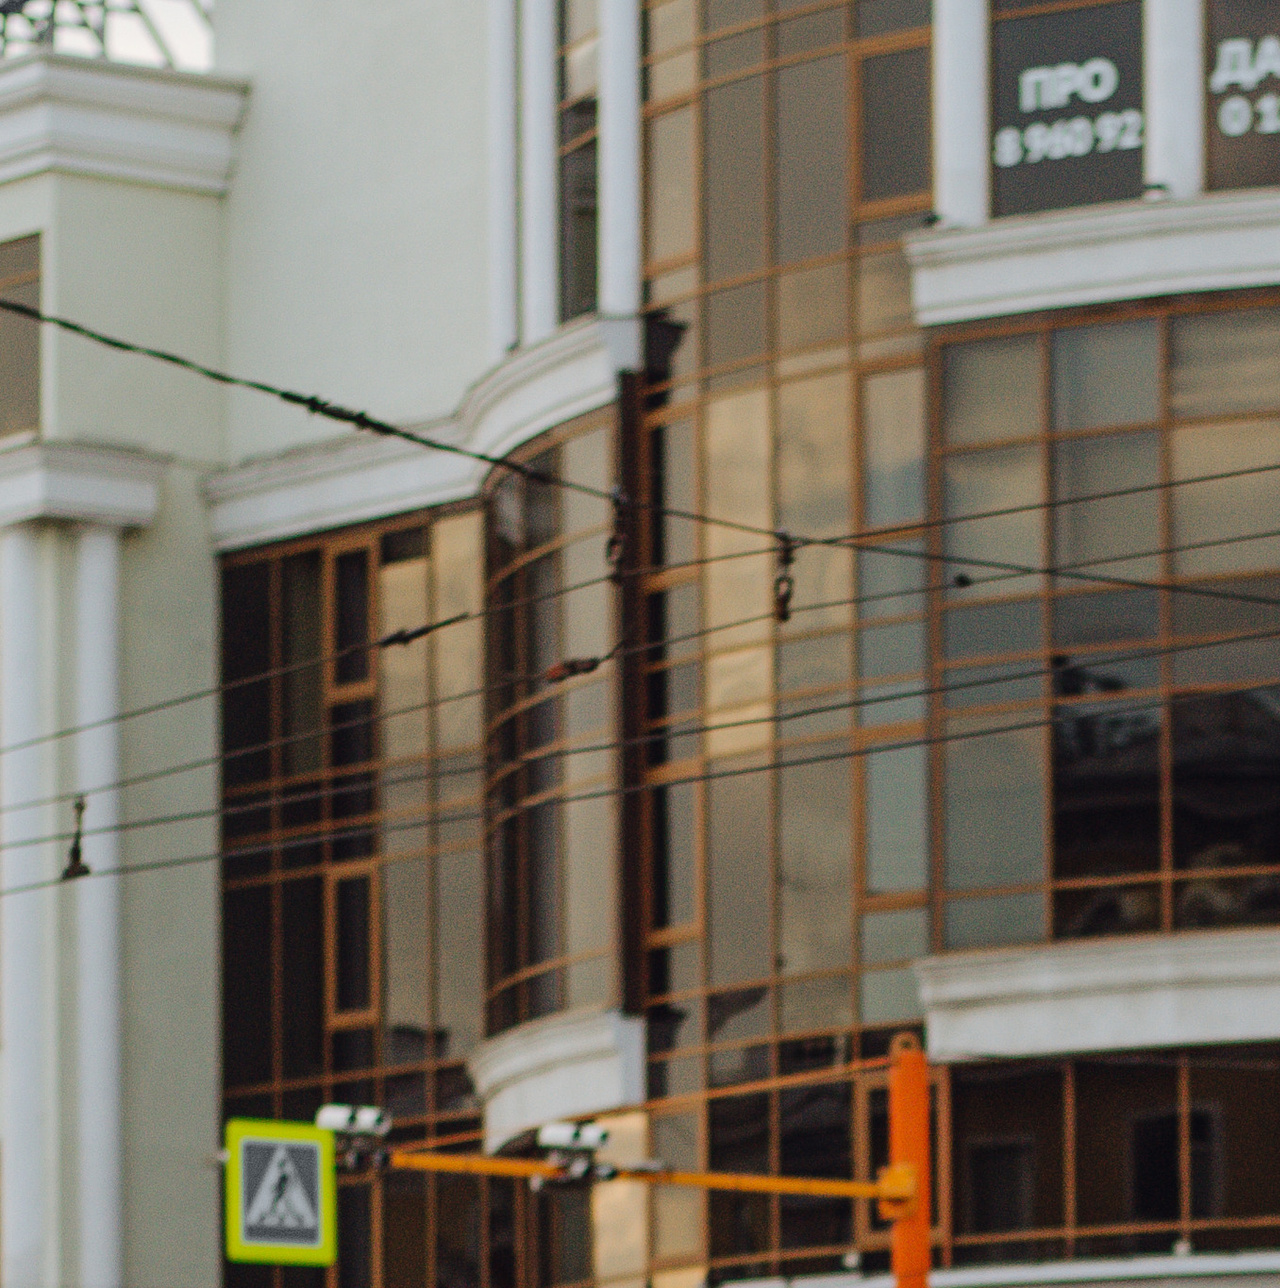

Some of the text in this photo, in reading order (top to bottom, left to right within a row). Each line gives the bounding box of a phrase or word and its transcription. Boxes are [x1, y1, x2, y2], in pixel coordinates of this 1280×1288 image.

[1019, 57, 1120, 113] ПРО
[994, 126, 1024, 168] 8
[1095, 108, 1144, 153] 92
[1217, 94, 1252, 137] 0
